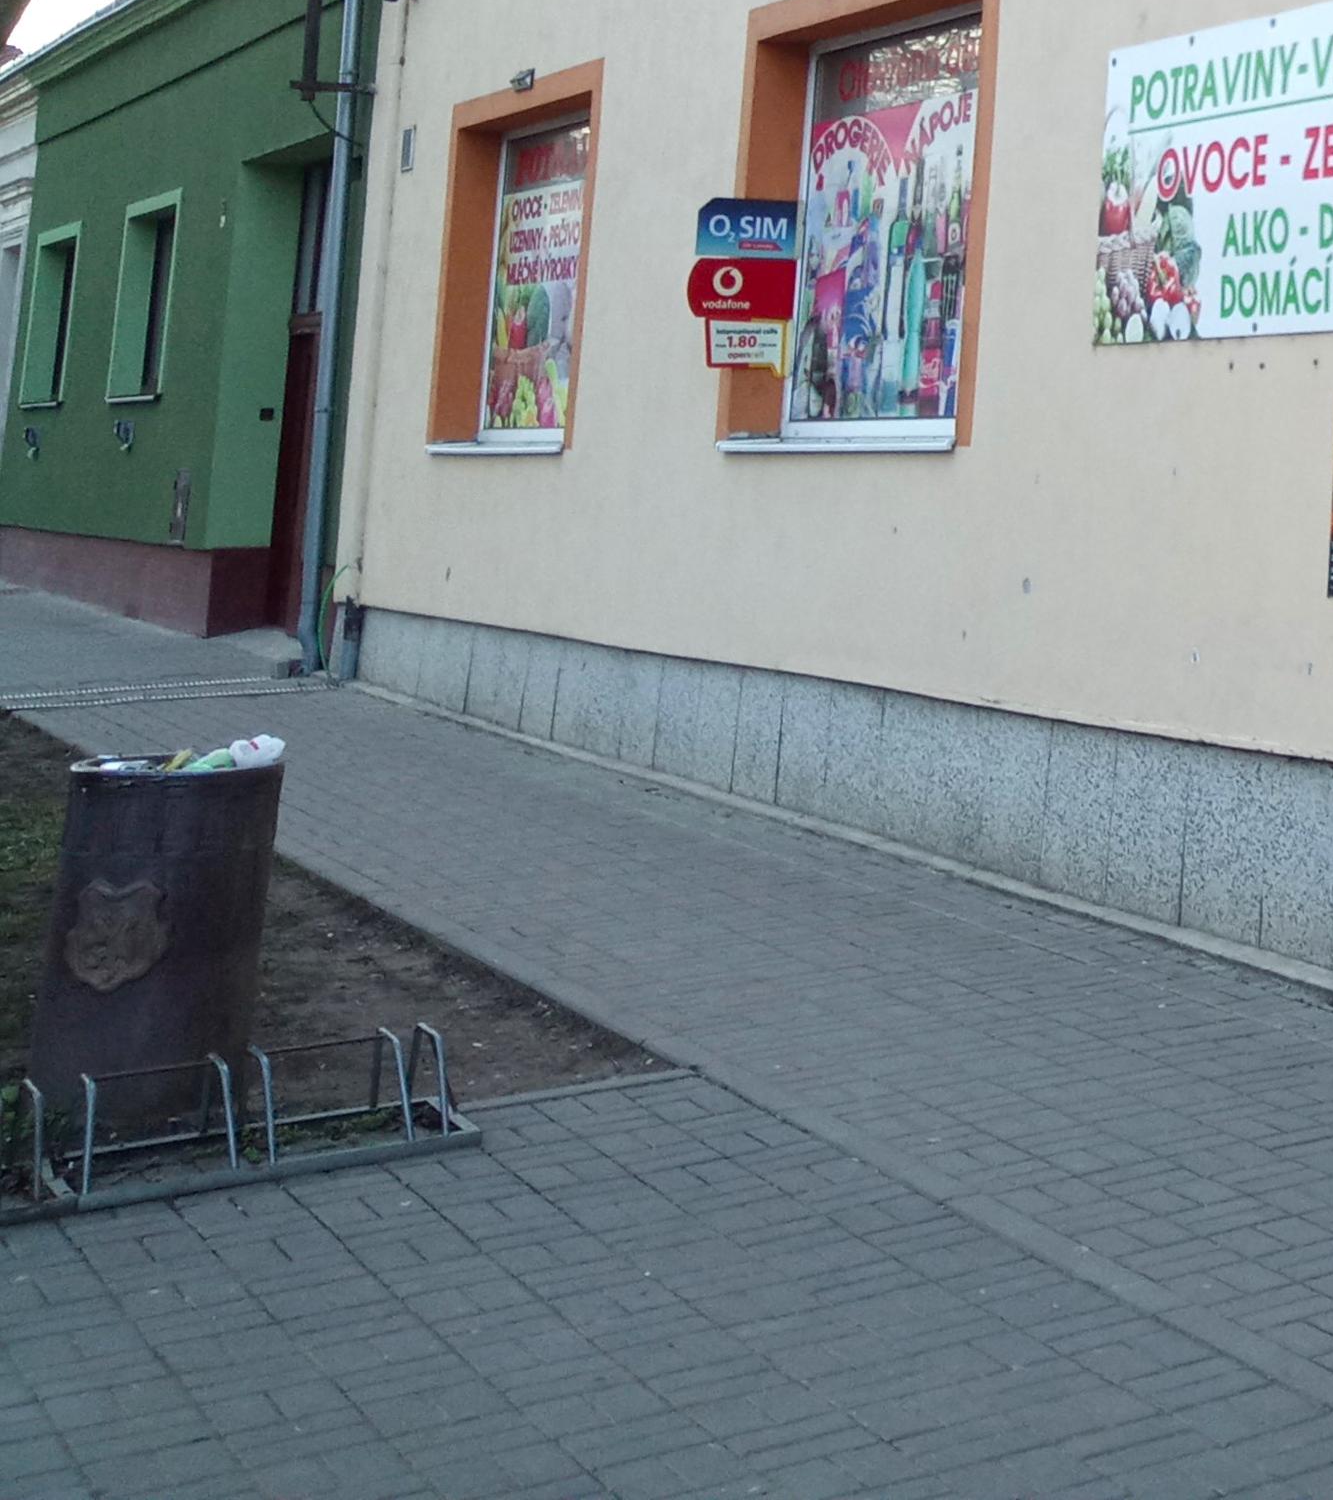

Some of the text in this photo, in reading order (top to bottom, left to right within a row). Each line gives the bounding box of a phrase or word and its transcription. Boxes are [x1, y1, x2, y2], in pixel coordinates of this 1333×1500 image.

[812, 118, 892, 187] DROGERIE
[1157, 133, 1269, 202] OVOCE
[511, 194, 544, 222] OVOCE
[739, 215, 788, 241] SIM
[1222, 206, 1290, 258] ALKO
[702, 299, 751, 310] vodafone
[1219, 254, 1333, 320] DOMÁCÍ
